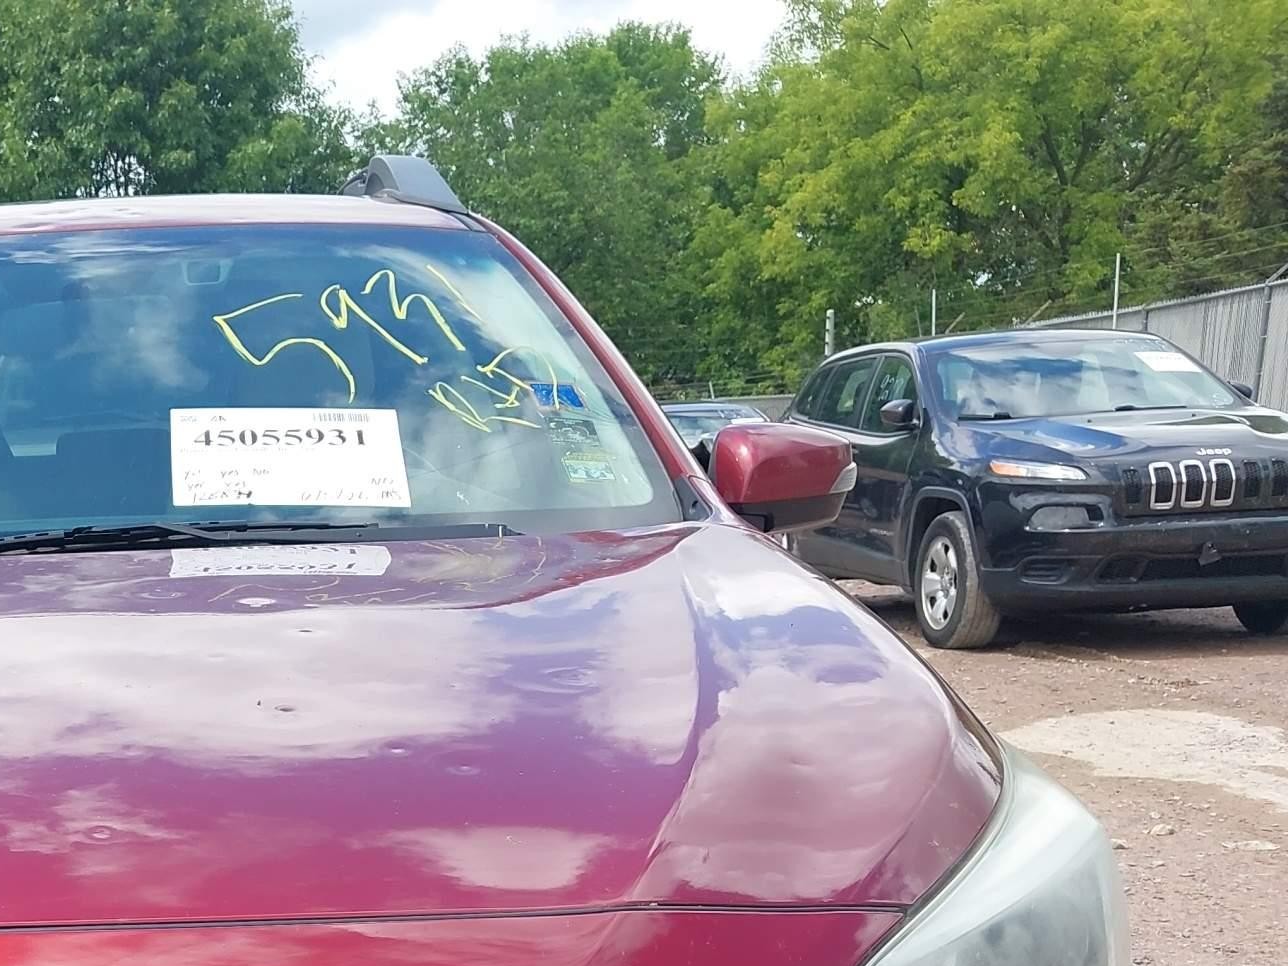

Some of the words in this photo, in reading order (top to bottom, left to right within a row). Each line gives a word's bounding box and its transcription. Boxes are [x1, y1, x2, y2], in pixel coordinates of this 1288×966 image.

[212, 264, 483, 403] 5931
[192, 428, 366, 447] 45055931
[1195, 446, 1232, 456] Jeep
